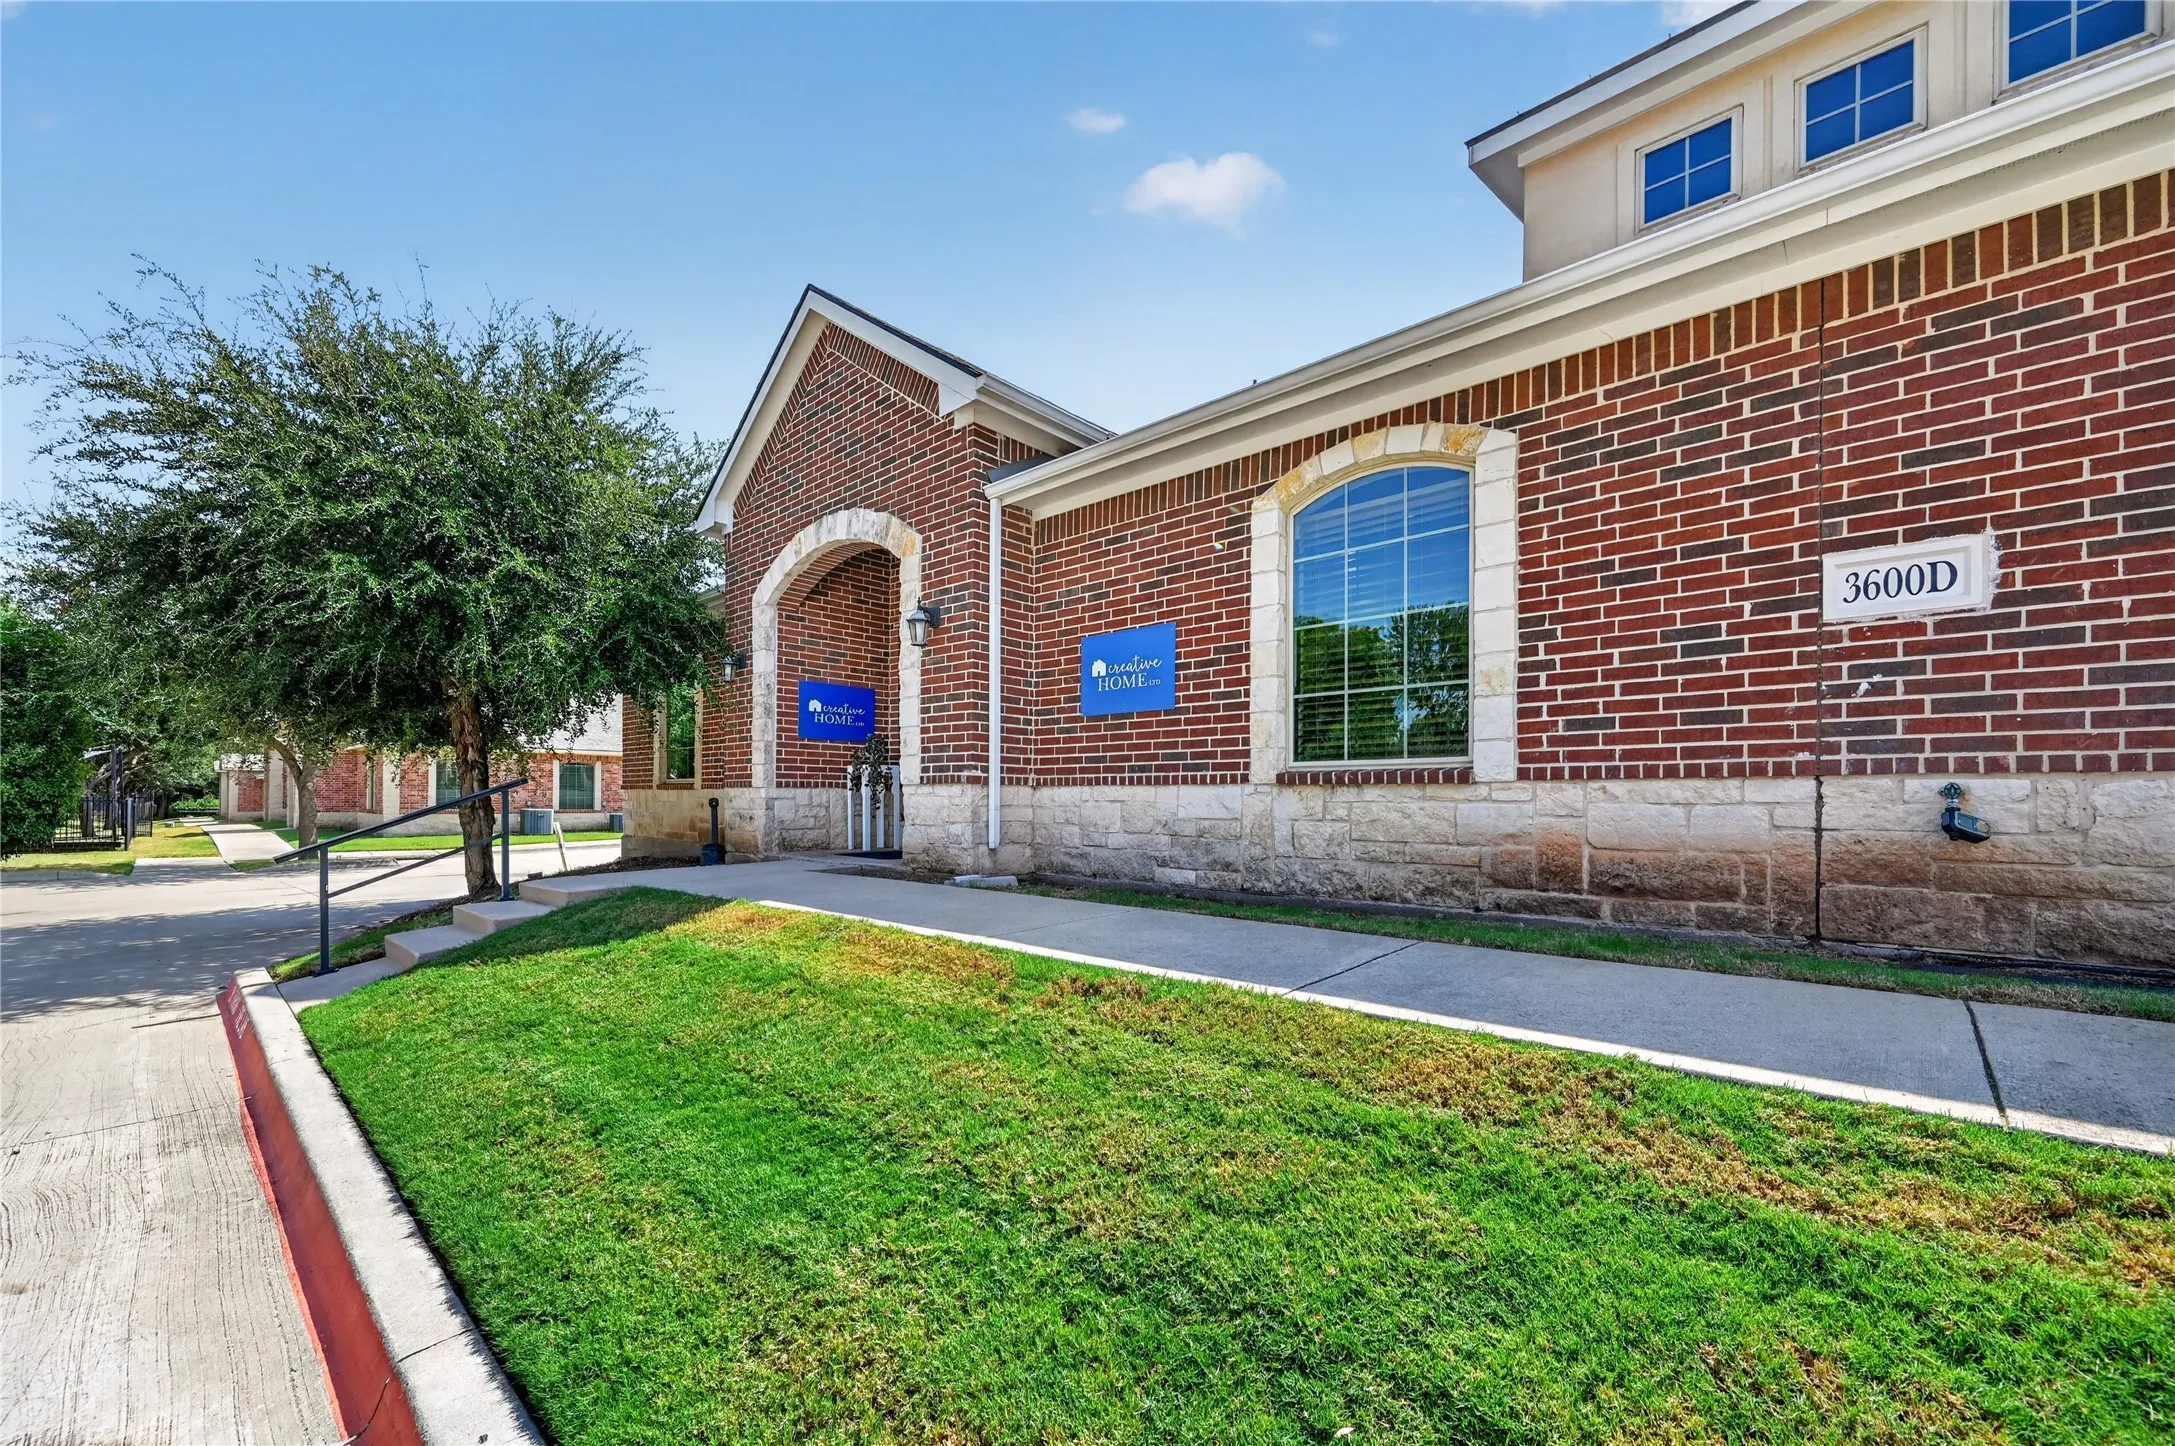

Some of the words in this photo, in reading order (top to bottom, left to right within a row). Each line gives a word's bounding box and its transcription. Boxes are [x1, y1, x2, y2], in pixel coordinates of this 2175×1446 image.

[1842, 560, 1958, 604] 3600D
[1108, 654, 1162, 674] creative
[1097, 672, 1148, 692] HOME
[823, 703, 866, 715] creative
[814, 713, 855, 726] HOME
